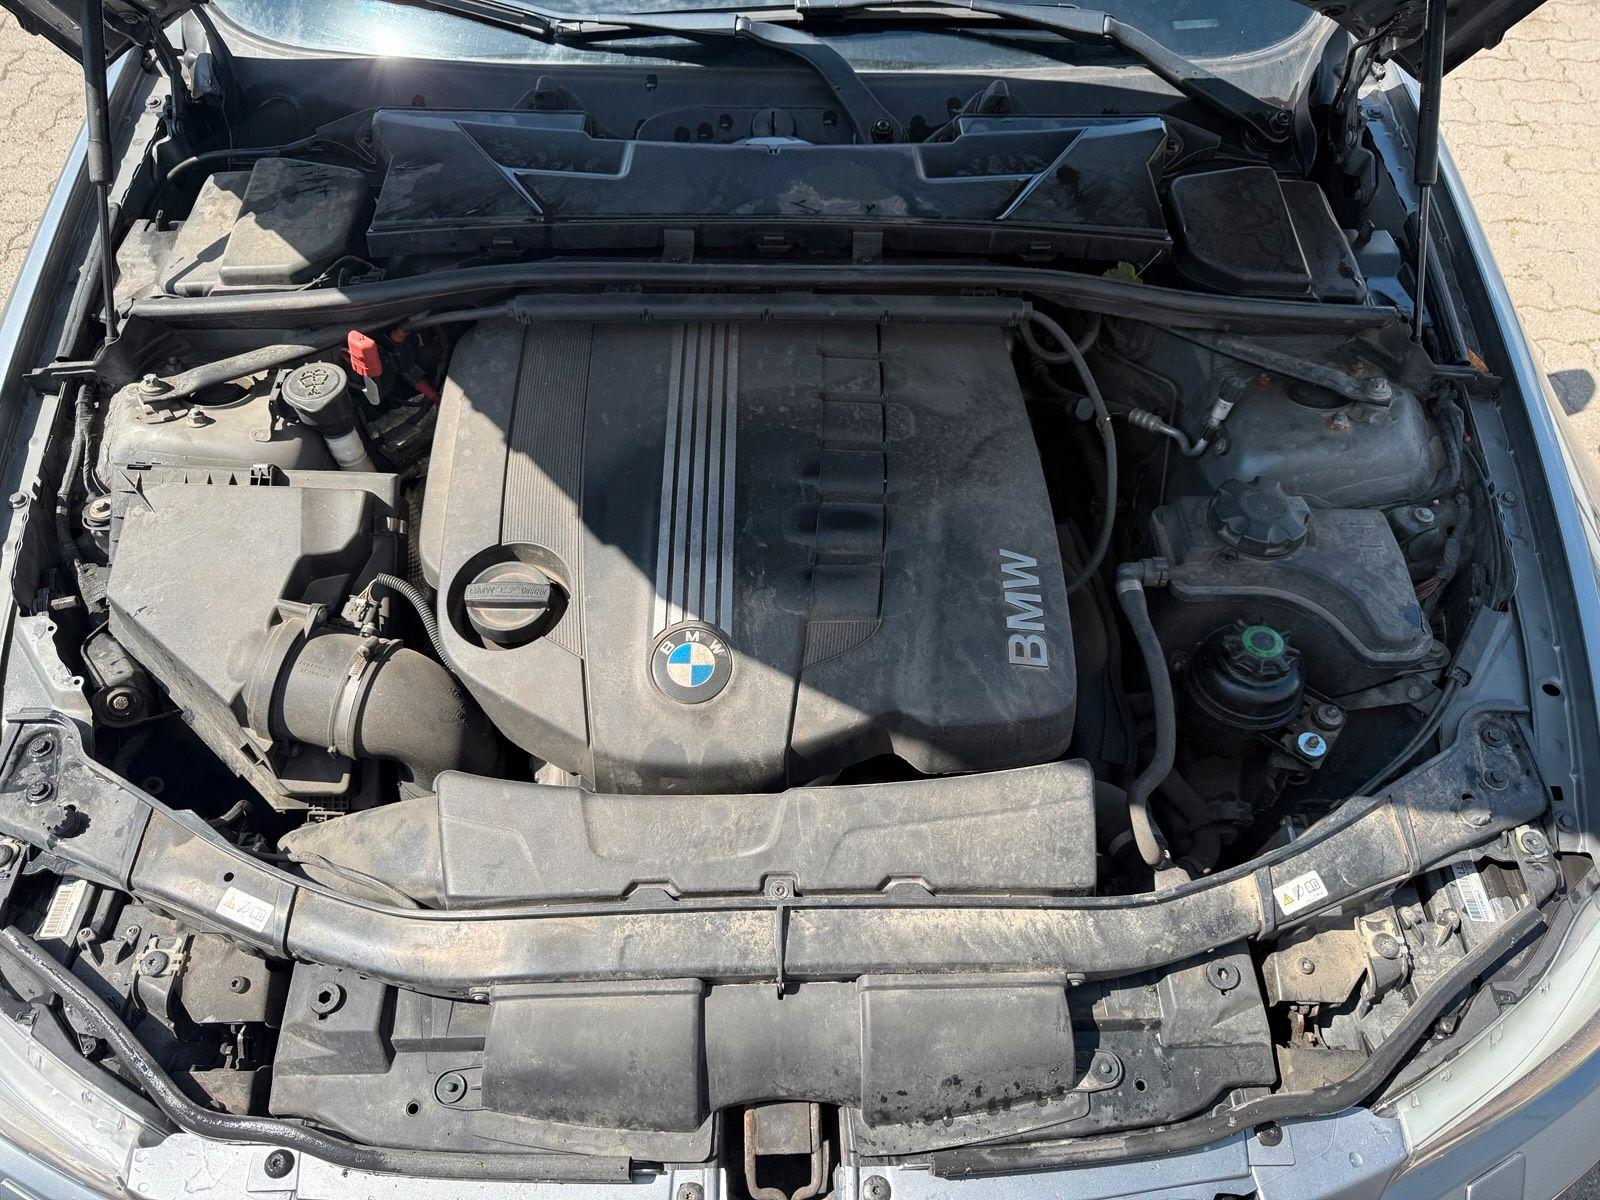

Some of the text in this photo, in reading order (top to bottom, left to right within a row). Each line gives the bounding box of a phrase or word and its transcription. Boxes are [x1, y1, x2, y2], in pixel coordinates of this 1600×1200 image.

[521, 586, 547, 596] Castrol
[999, 548, 1049, 668] BMW
[660, 630, 726, 655] BMW
